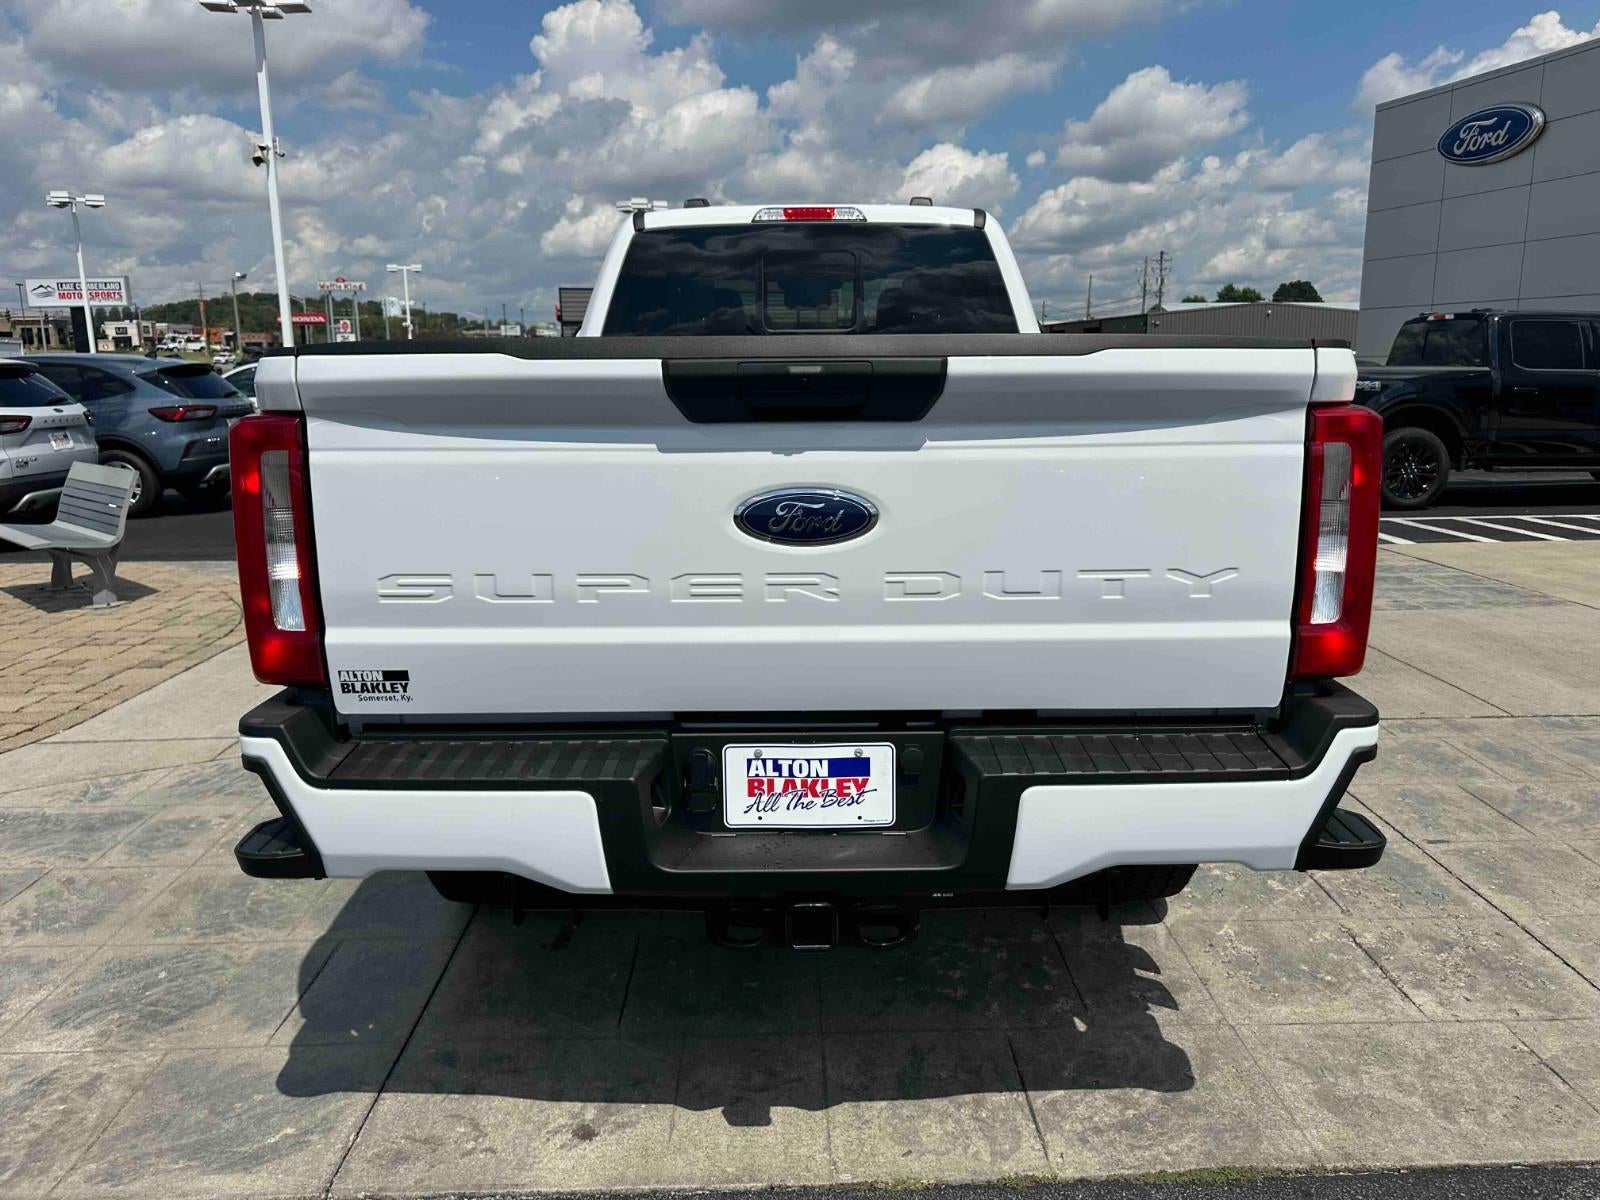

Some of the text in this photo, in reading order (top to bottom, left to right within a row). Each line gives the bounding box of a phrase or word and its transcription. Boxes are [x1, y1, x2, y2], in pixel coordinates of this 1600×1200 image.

[1453, 117, 1512, 156] Ford
[58, 282, 120, 291] LAKE CMBERLAND
[58, 291, 123, 300] MOTOSPORTS
[768, 501, 845, 533] Ford
[377, 566, 1240, 604] SUPER DUTY
[340, 670, 384, 682] ALTON
[340, 682, 409, 694] BLAKLEY
[401, 694, 414, 702] Ky.
[748, 759, 829, 778] ALTON
[747, 777, 870, 798] BLAKLEY
[744, 788, 878, 814] All The Best
